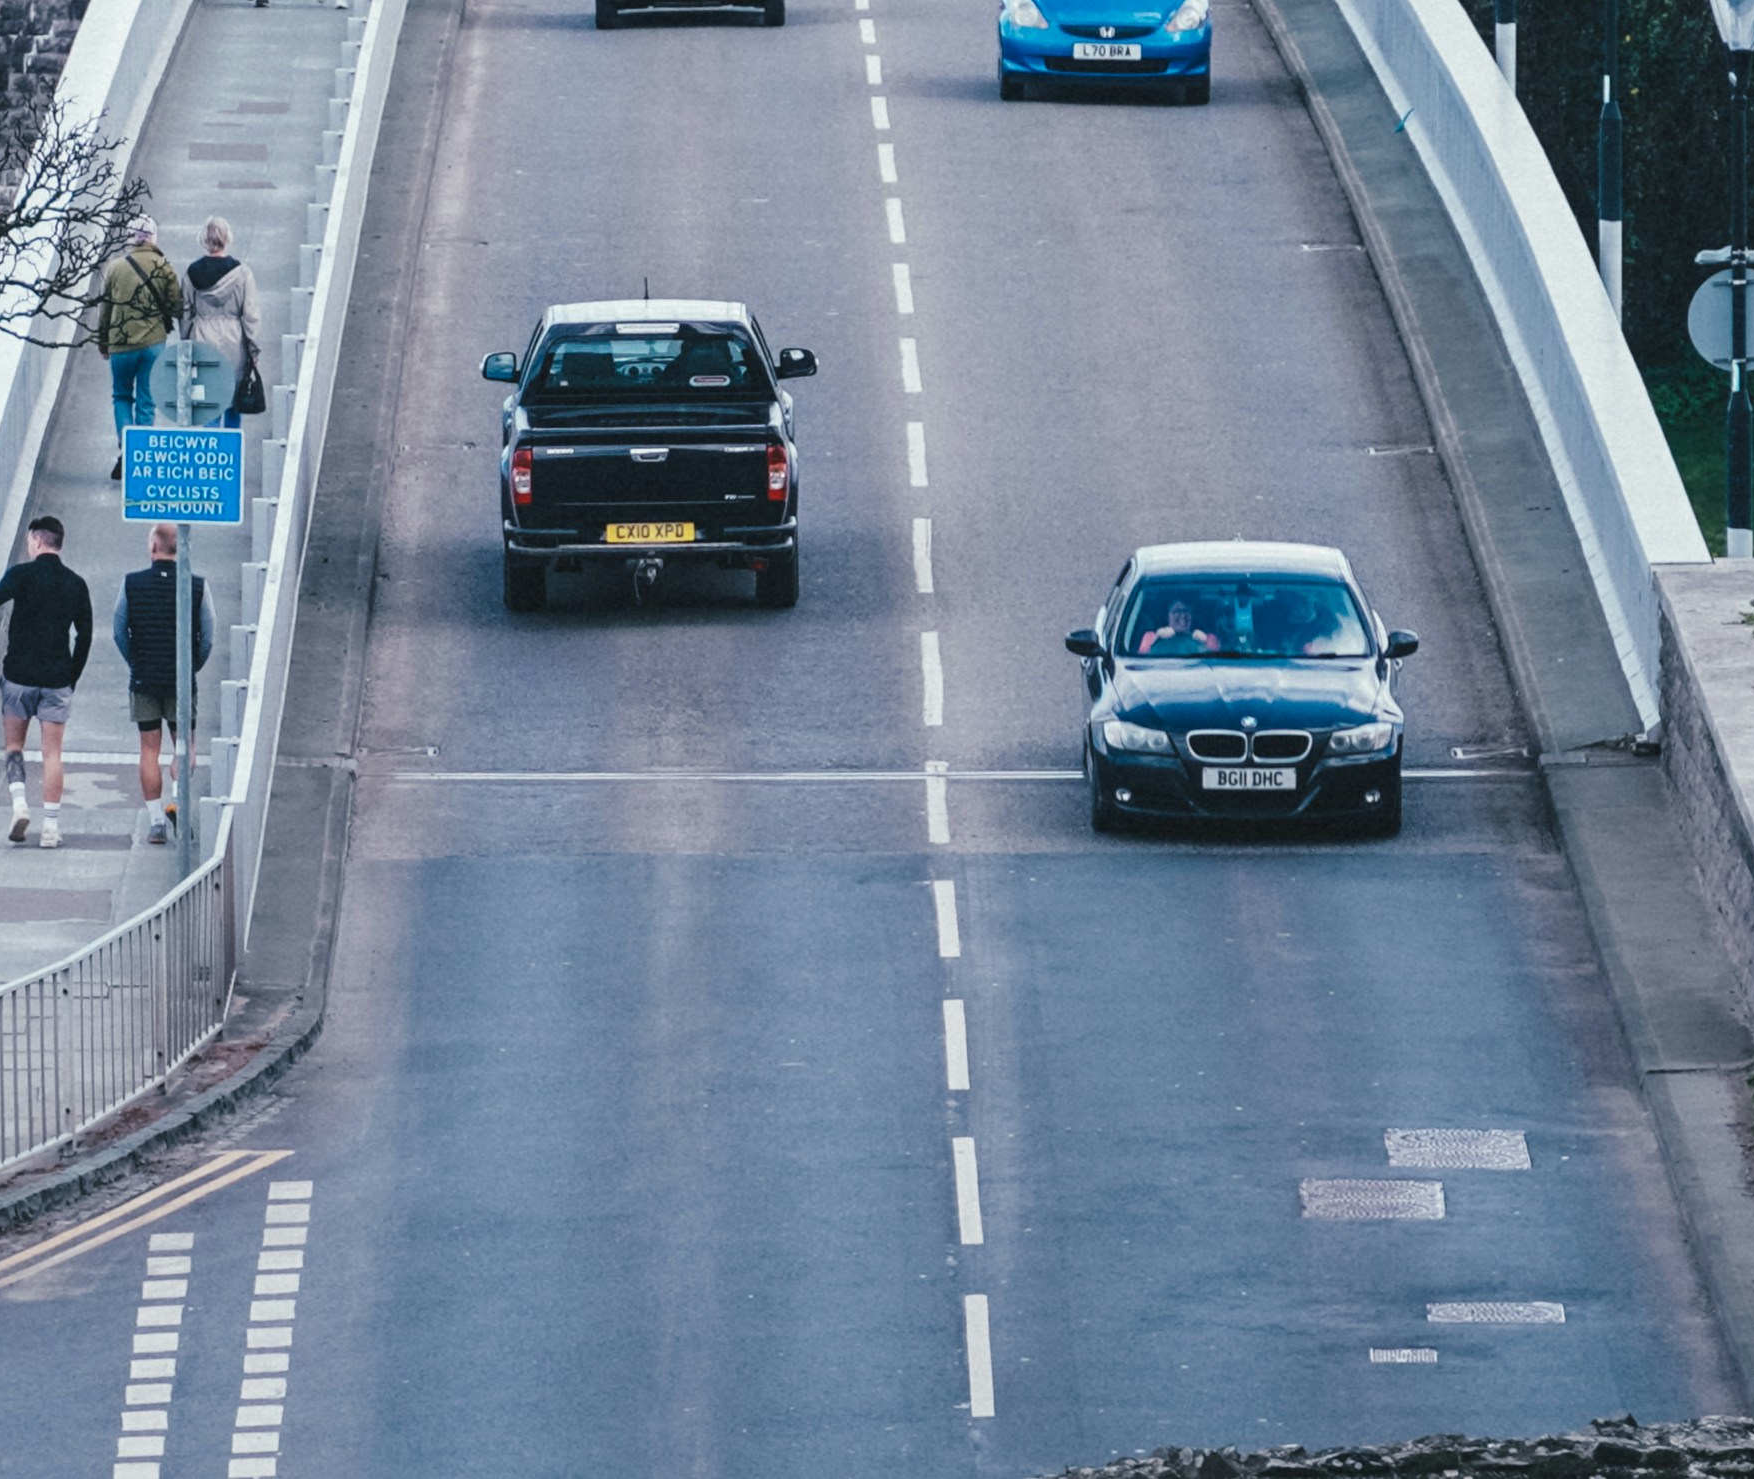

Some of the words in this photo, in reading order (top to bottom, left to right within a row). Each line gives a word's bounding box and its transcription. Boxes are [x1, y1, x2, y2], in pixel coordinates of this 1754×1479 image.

[1083, 45, 1106, 57] L70
[1110, 46, 1132, 57] BRA
[148, 435, 218, 449] BEICWYR
[133, 450, 189, 464] DEWCH
[194, 452, 234, 465] ODDI
[132, 465, 152, 478] AR
[157, 466, 194, 479] EICH
[198, 467, 235, 481] BEIC
[146, 485, 220, 500] CYCLISTS
[140, 501, 224, 515] DISMOUNT
[616, 524, 650, 539] CX10
[655, 523, 685, 538] XPD
[1217, 770, 1247, 786] BG11
[1252, 771, 1284, 787] DHC
